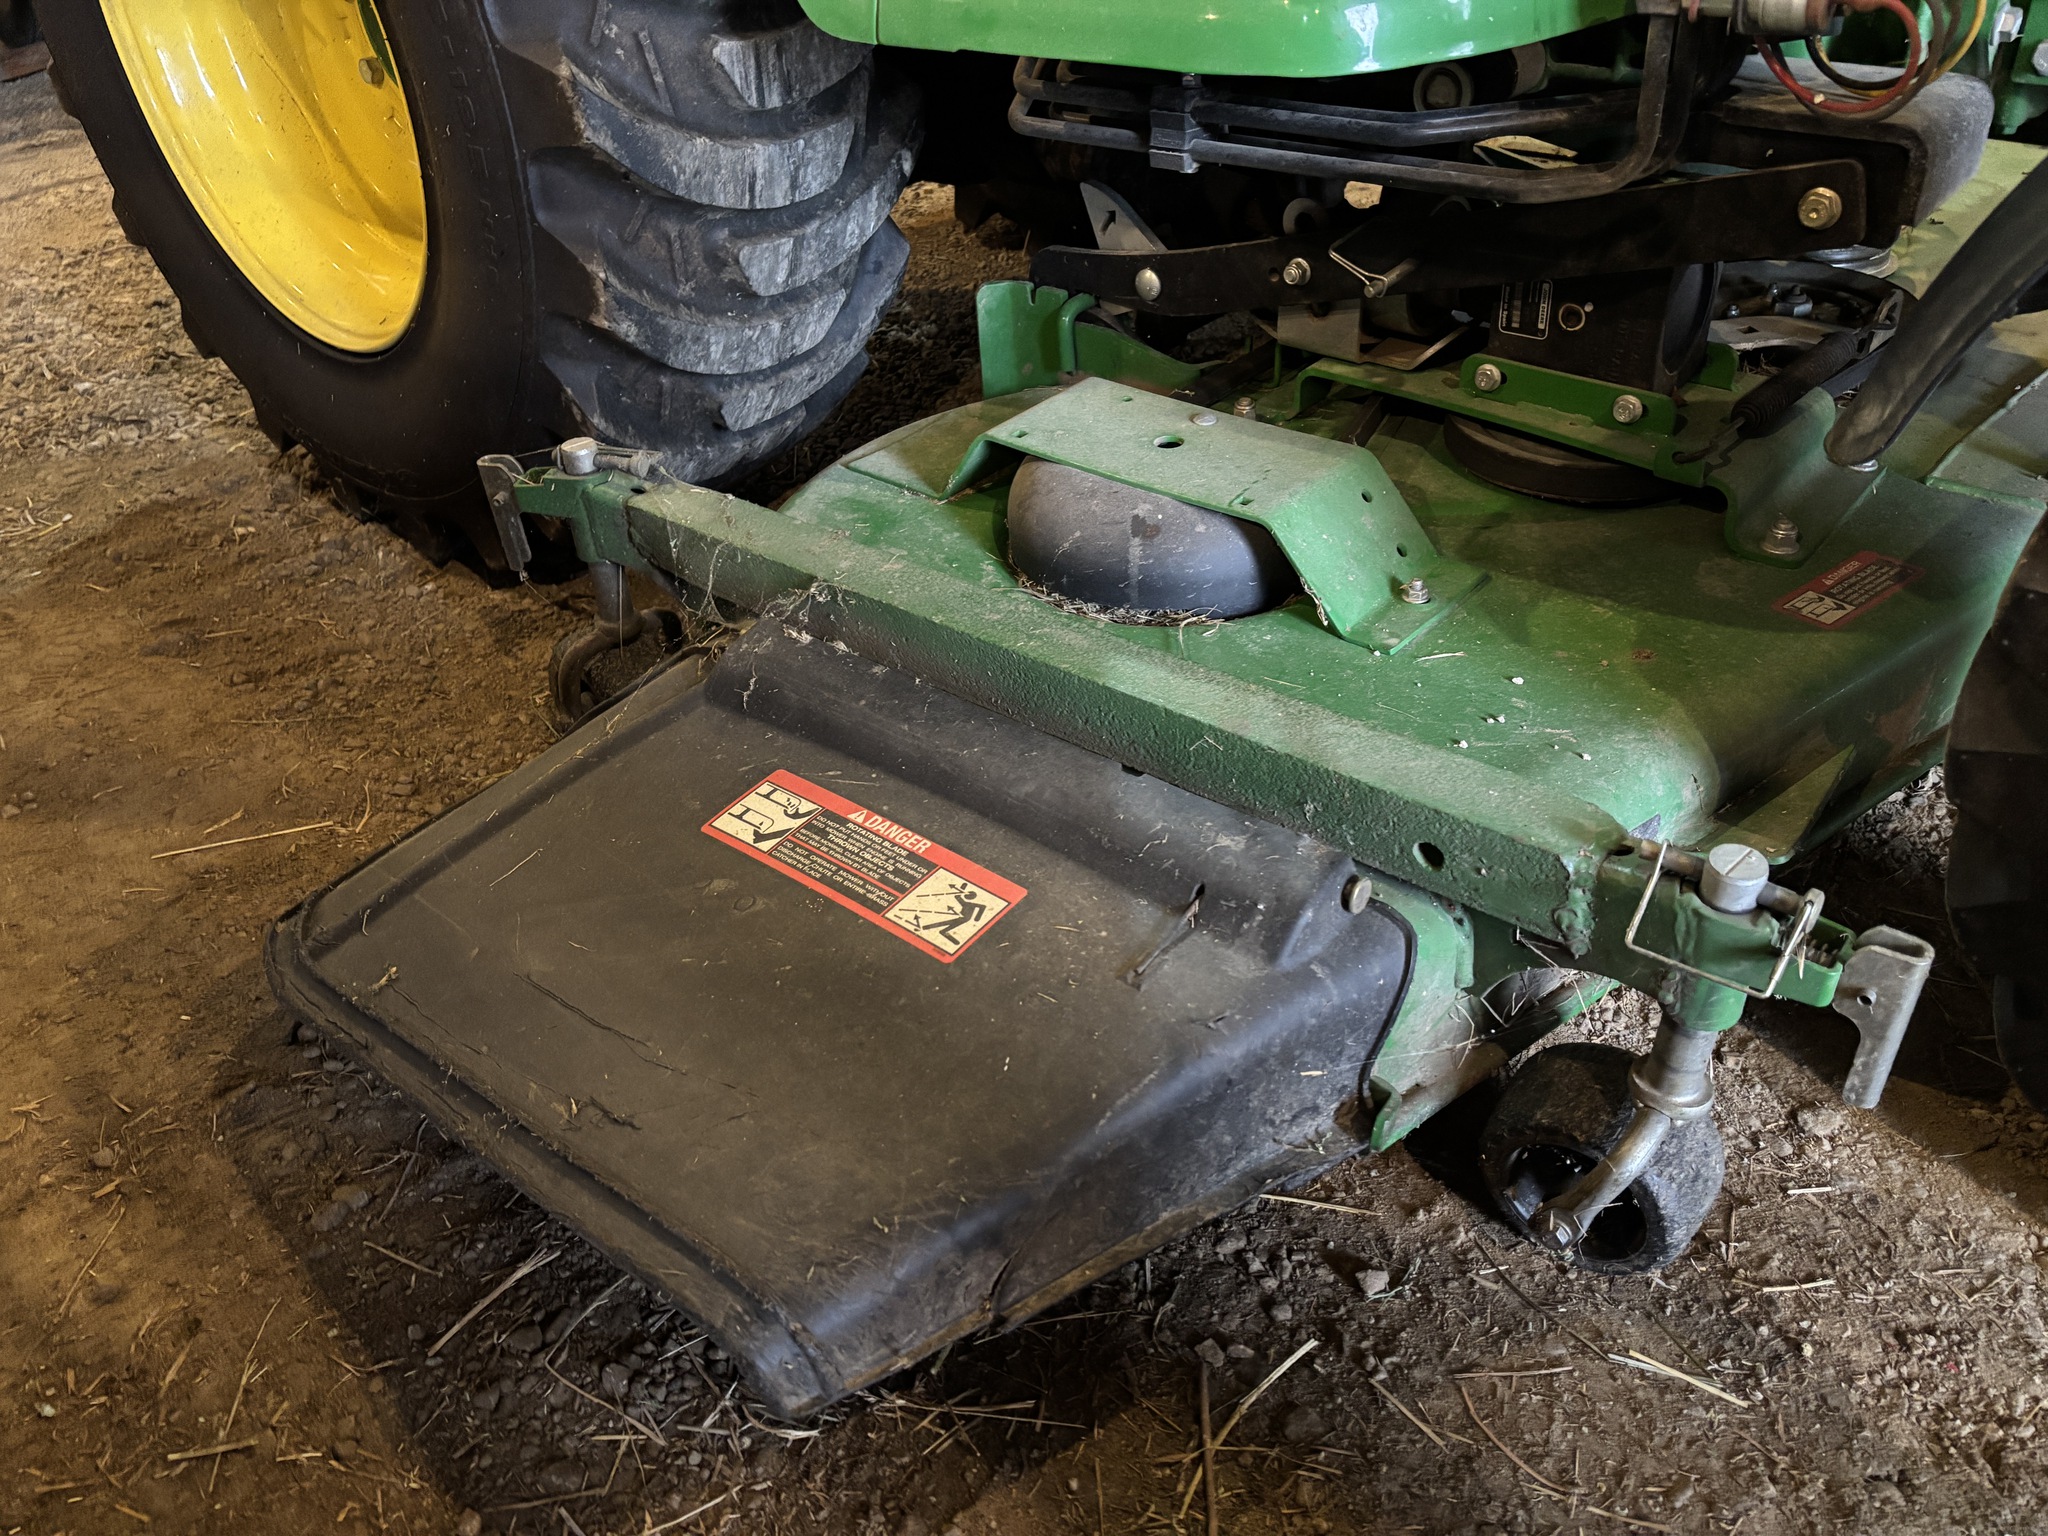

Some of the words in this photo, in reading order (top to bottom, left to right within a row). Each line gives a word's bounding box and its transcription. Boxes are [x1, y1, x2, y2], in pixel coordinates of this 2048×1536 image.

[1827, 560, 1862, 579] DANGER
[771, 849, 798, 865] CATCHER
[794, 832, 809, 842] THAT
[807, 839, 822, 848] MAY
[828, 849, 854, 865] THROWN
[860, 866, 881, 879] BLADE
[800, 828, 822, 841] BEFORE
[844, 850, 864, 862] CLEAR
[861, 859, 878, 870] AREA
[884, 871, 912, 887] OBJECTS
[810, 819, 826, 829] INTO
[824, 826, 848, 840] MOWER
[847, 837, 866, 849] WHEN
[865, 847, 888, 860] ENGINE
[895, 862, 923, 878] RUNNING
[825, 820, 840, 829] NOT
[837, 826, 852, 835] PUT
[850, 832, 873, 845] HANDS
[871, 842, 882, 850] OR
[880, 847, 896, 857] FEET
[895, 855, 919, 868] UNDER
[917, 865, 929, 874] OR
[826, 833, 861, 853] THROWN
[858, 850, 896, 871] OBJECTS
[845, 822, 884, 843] ROTATING
[882, 840, 910, 856] BLADE
[863, 815, 933, 853] DANGER
[777, 845, 812, 865] DISCHARGE
[811, 863, 833, 876] CHUTE
[832, 874, 844, 882] OR
[843, 880, 867, 894] ENTIRE
[783, 840, 794, 848] DO
[794, 846, 809, 856] NOT
[809, 854, 838, 871] OPERATE
[838, 869, 864, 885] MOWER
[864, 883, 895, 901] WITHOUT
